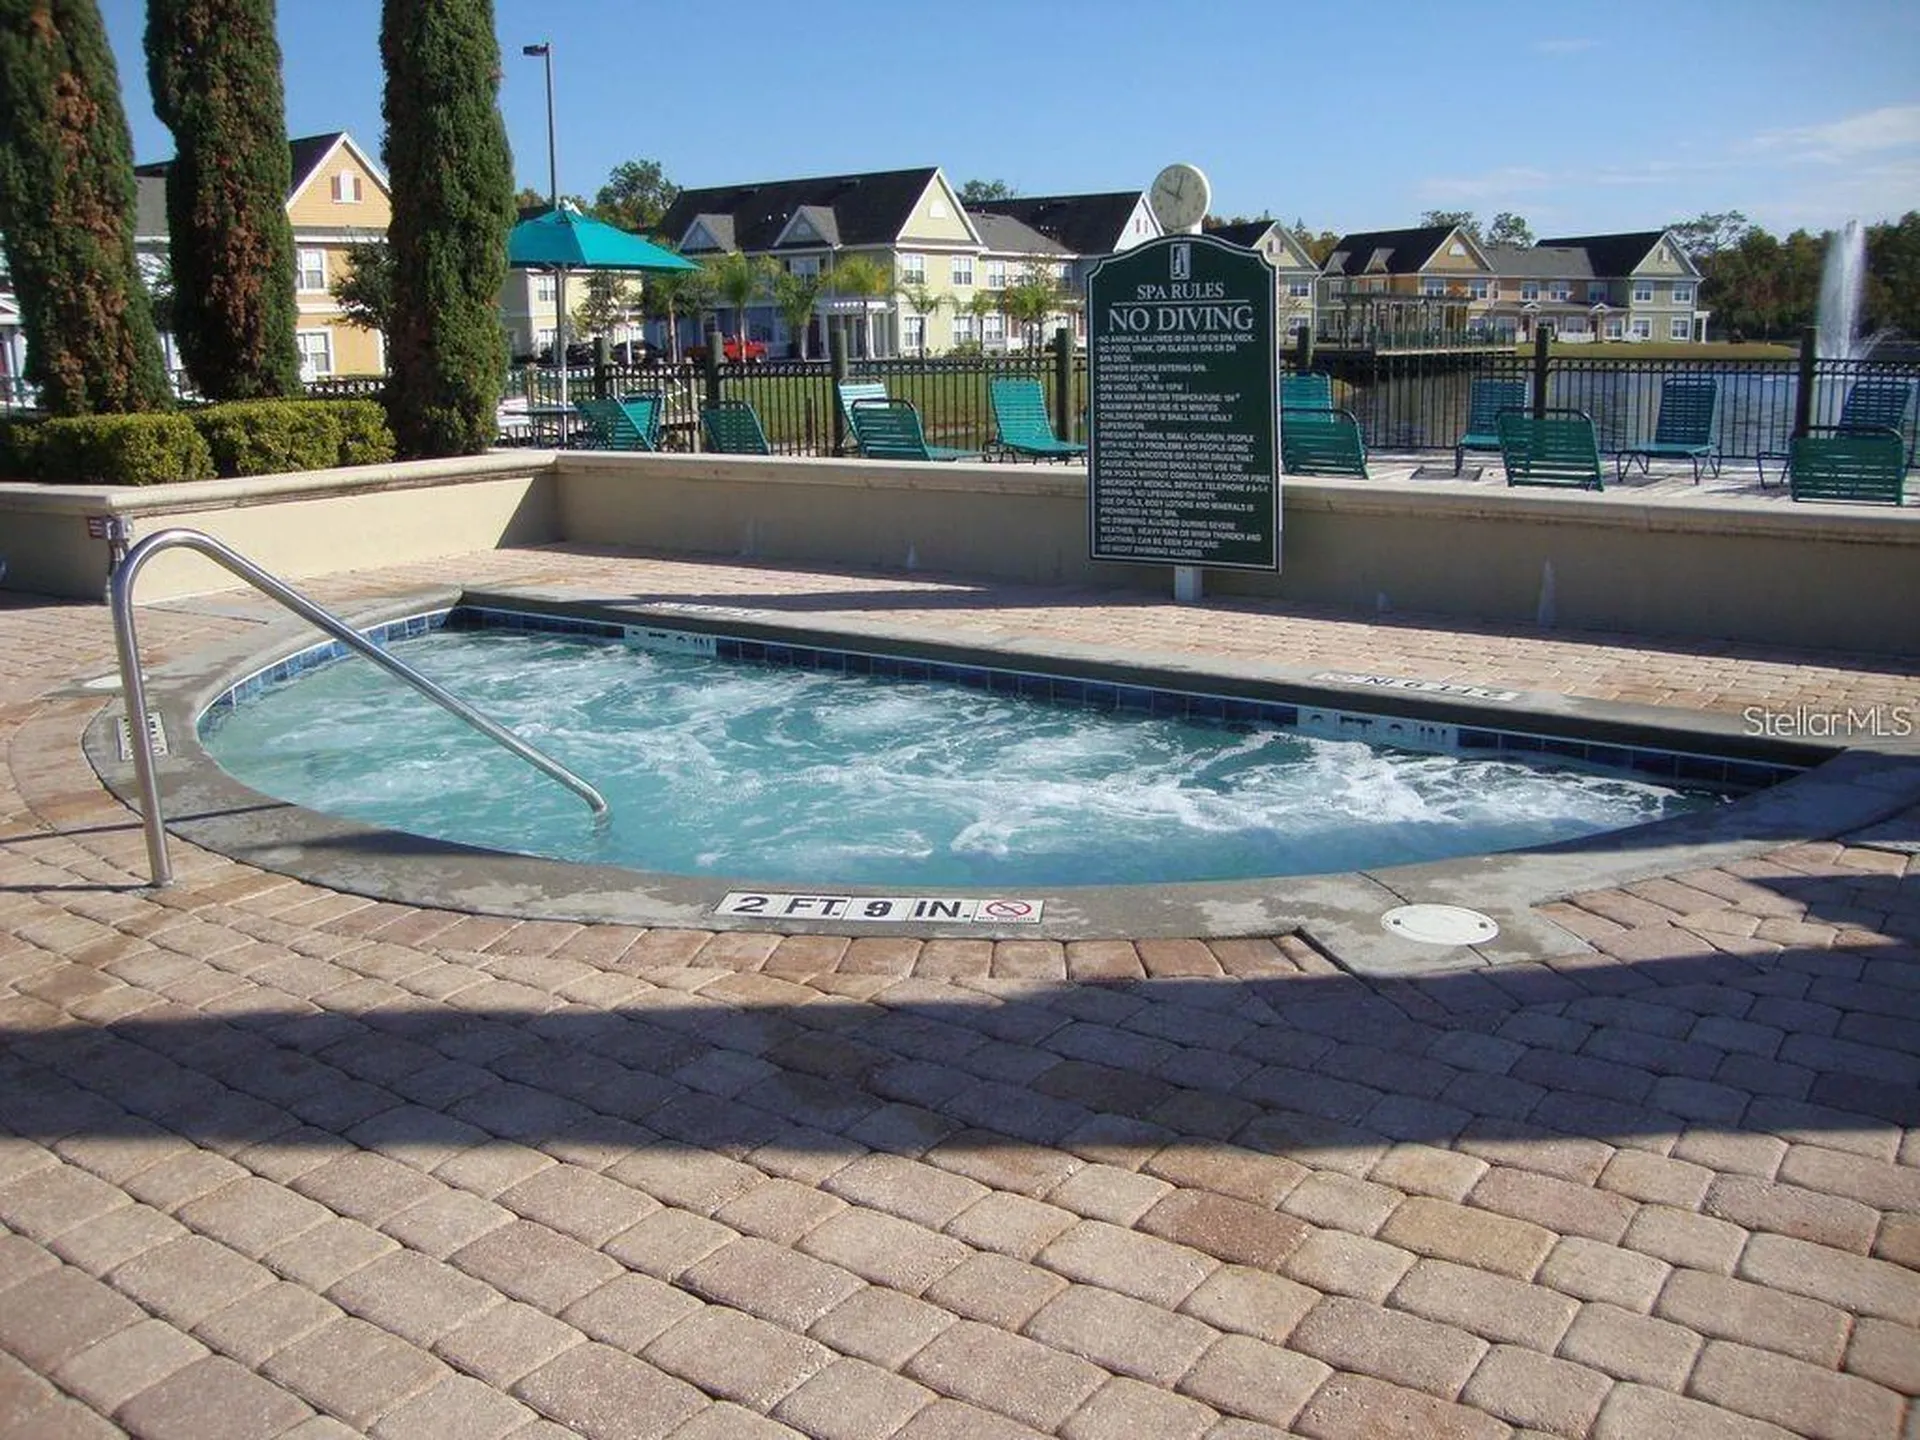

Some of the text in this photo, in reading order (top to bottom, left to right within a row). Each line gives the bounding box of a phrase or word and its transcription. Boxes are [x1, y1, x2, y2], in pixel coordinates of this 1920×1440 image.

[1137, 282, 1224, 300] SPA RULES
[1109, 305, 1254, 332] NO DIVING
[732, 896, 970, 918] 2 FT. 9 IN.
